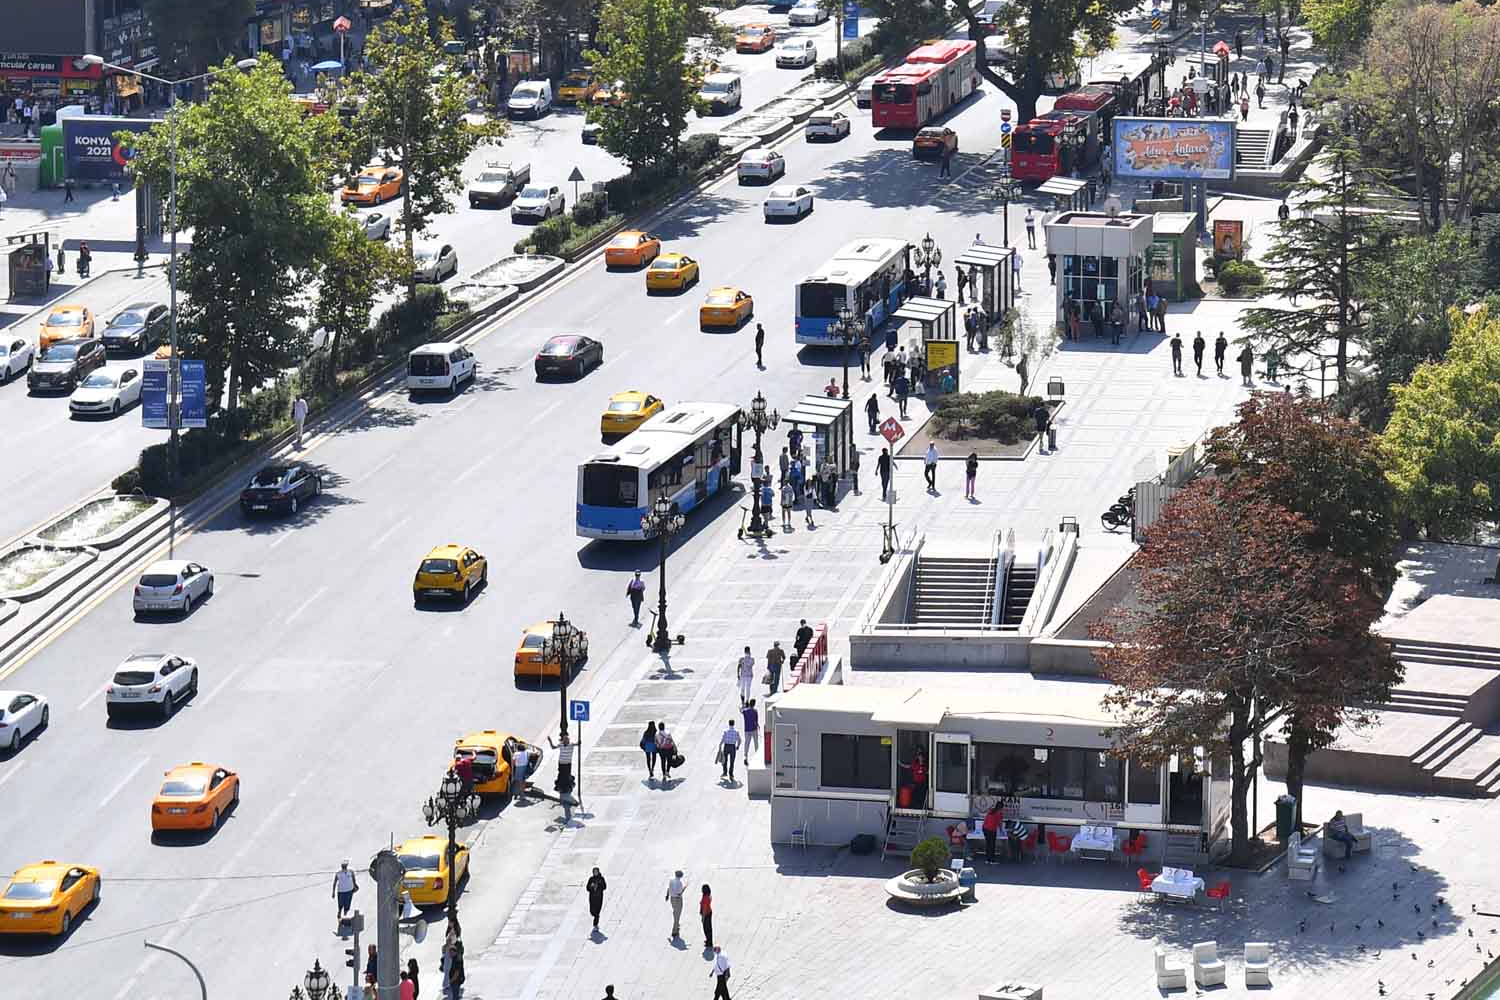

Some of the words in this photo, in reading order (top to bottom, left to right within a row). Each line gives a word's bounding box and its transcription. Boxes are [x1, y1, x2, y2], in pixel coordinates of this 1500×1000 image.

[75, 136, 112, 145] KONYA
[87, 147, 111, 156] 2021
[574, 702, 586, 719] P
